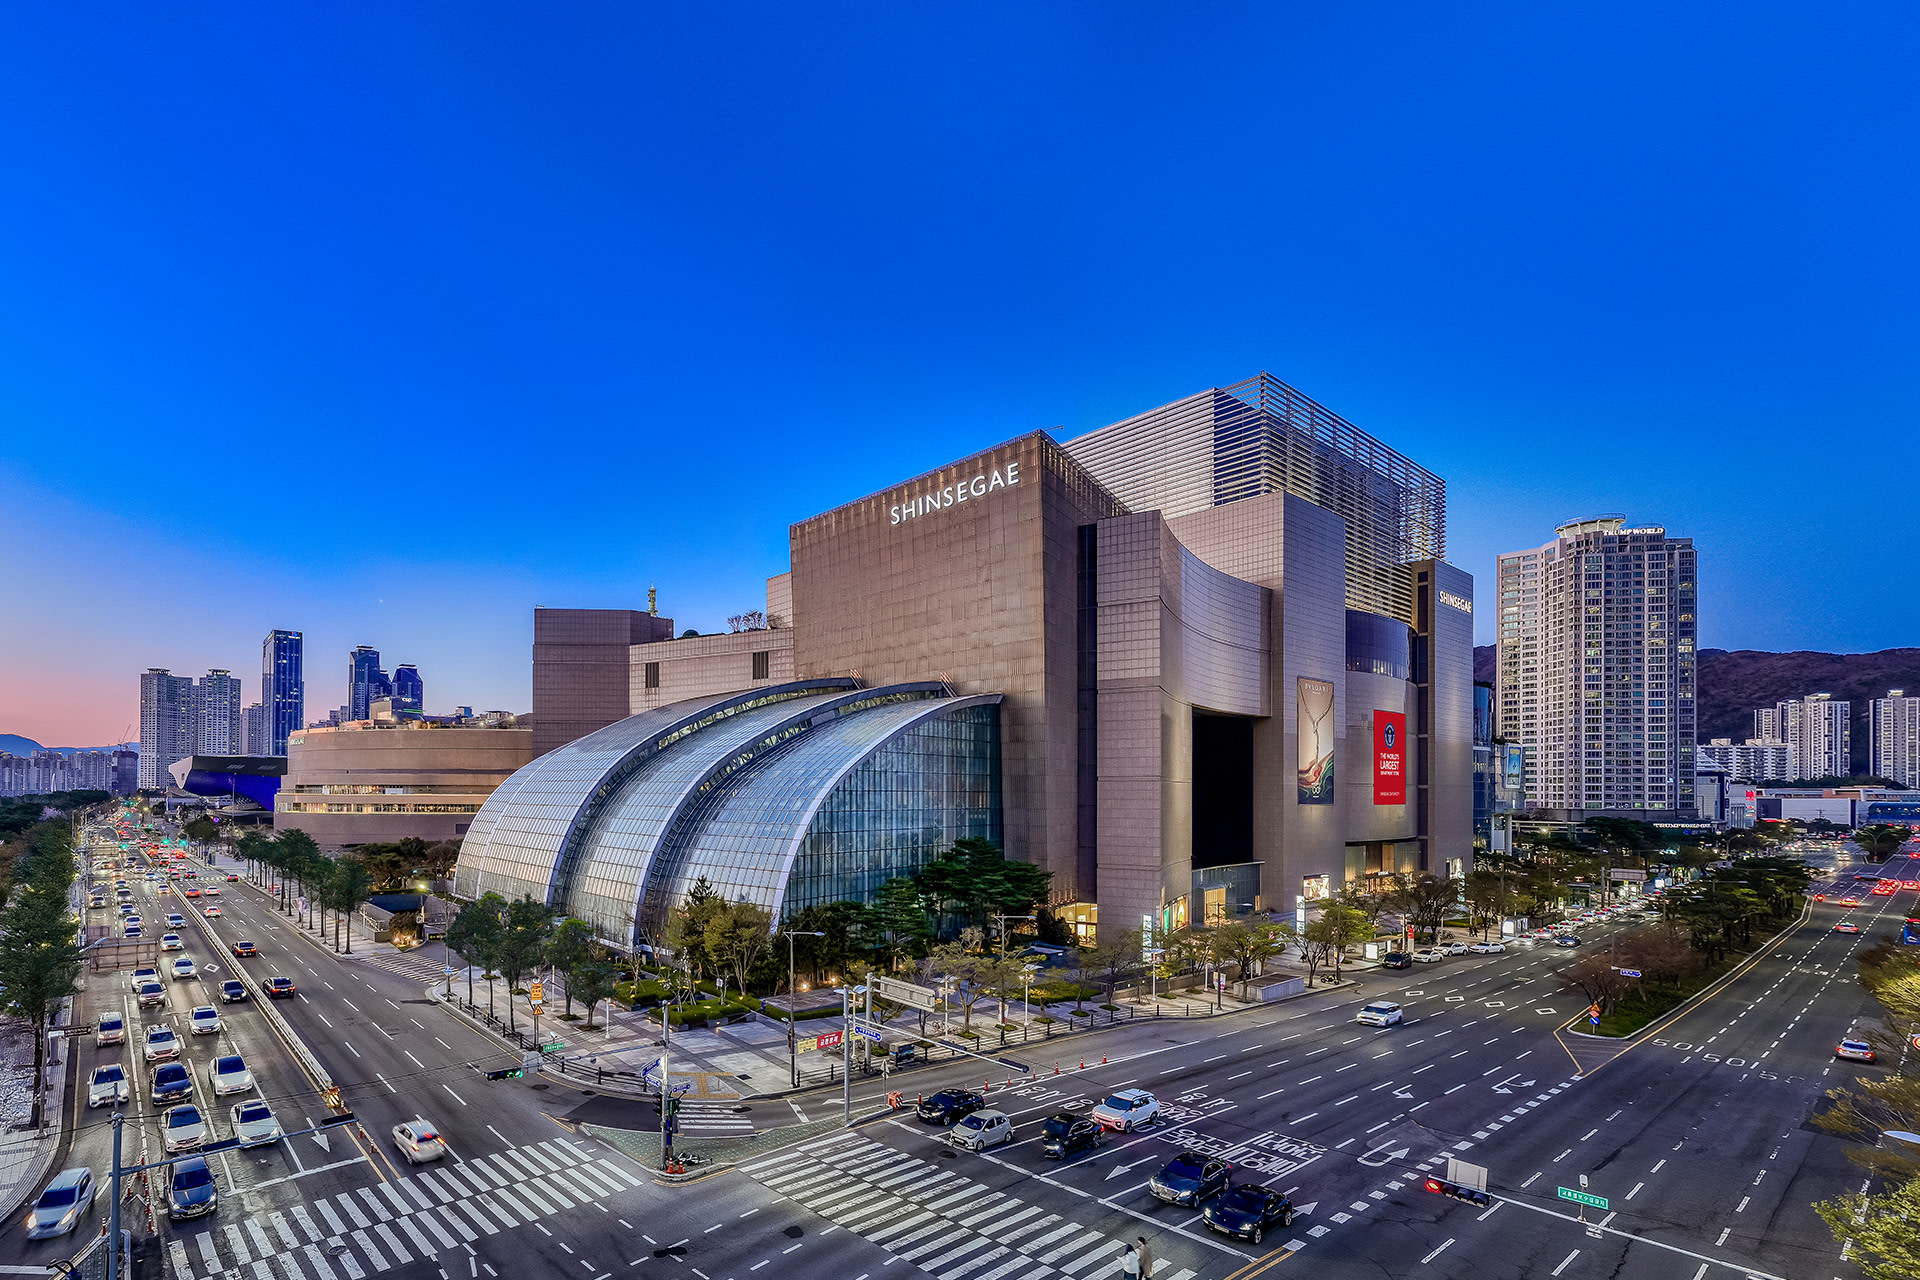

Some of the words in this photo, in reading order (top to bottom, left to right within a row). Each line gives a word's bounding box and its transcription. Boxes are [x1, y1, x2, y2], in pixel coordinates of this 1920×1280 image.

[890, 462, 1020, 525] SHINSEGAE
[1632, 527, 1664, 535] WORLD
[1439, 590, 1472, 614] SHINSEGAE
[1380, 760, 1400, 770] LARGEST
[1651, 1038, 1694, 1051] 50
[1701, 1052, 1746, 1067] 50
[1157, 1128, 1235, 1156] 문현동
[1219, 1146, 1299, 1175] 해운대
